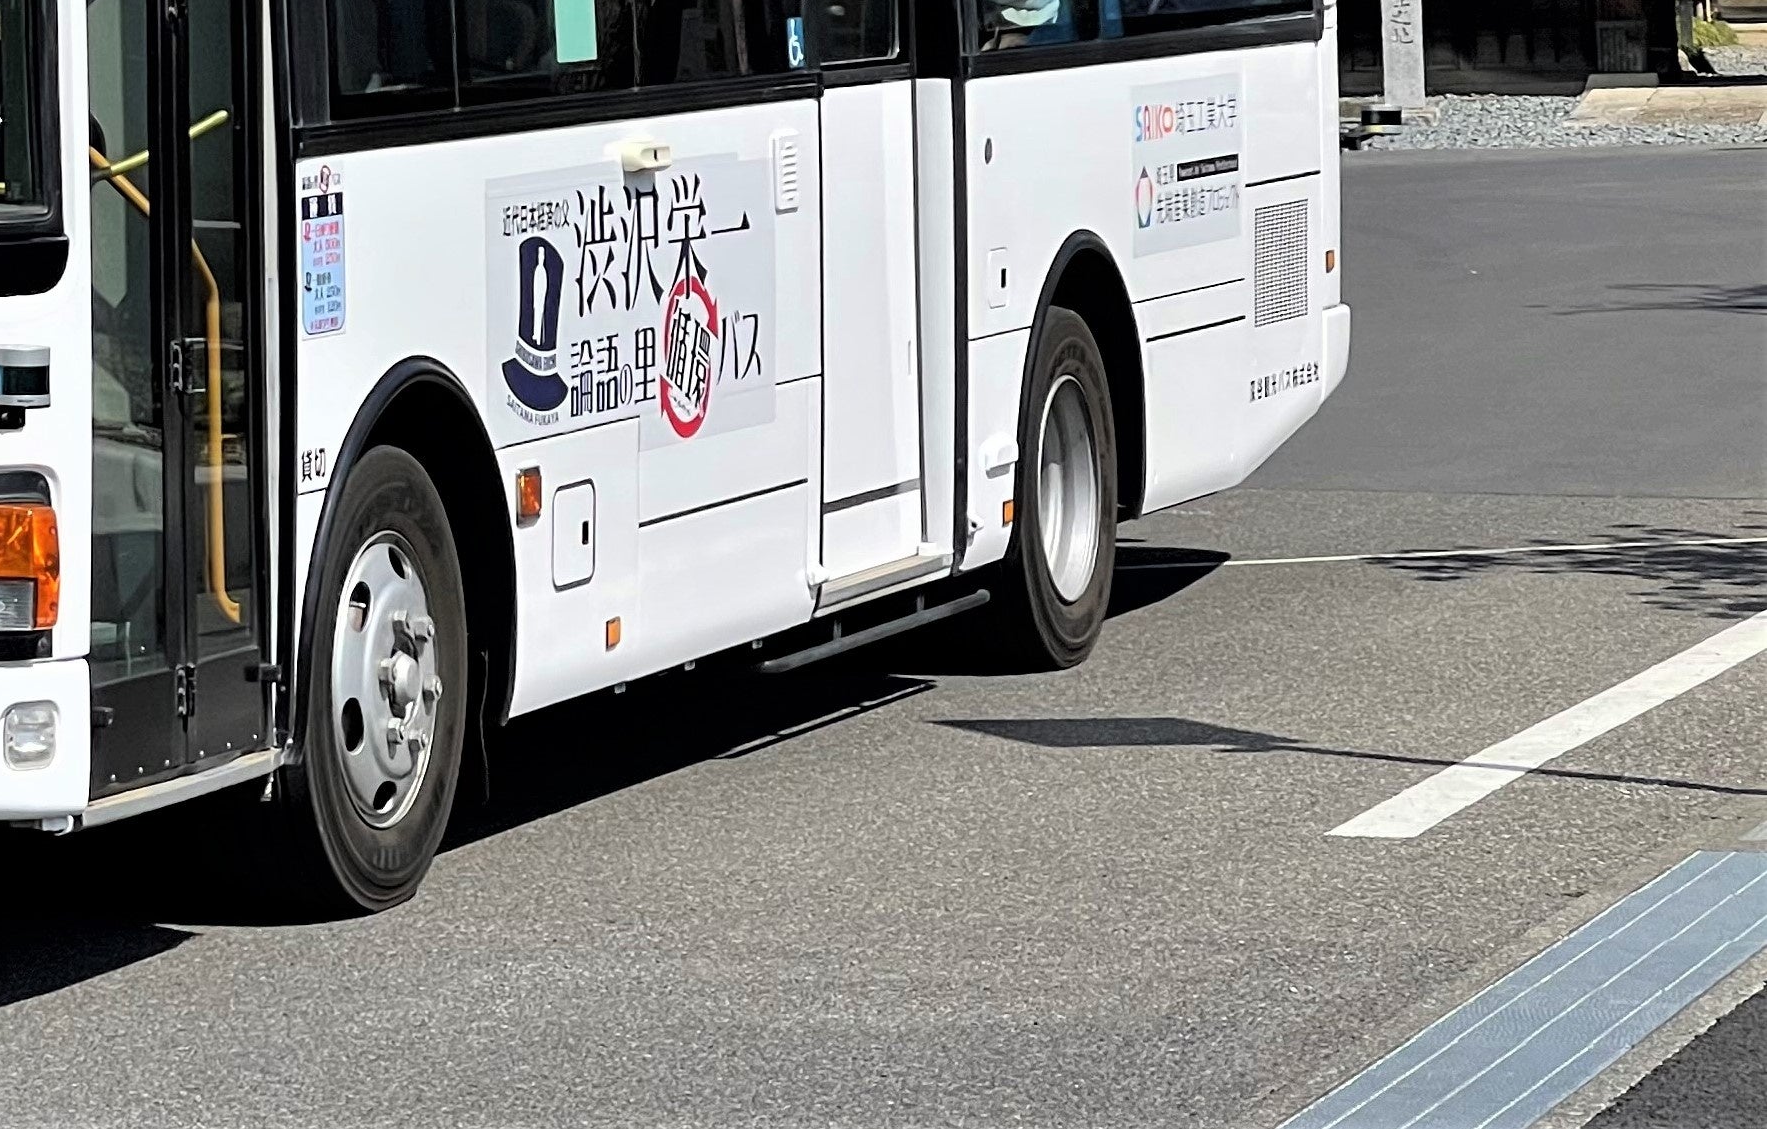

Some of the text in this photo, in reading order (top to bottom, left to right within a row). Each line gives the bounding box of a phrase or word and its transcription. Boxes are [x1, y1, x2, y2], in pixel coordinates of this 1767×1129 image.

[1135, 104, 1174, 142] SAIKO
[502, 198, 570, 237] 近代日本経済の父
[573, 173, 751, 318] 渋沢栄一
[301, 448, 326, 482] 貸切
